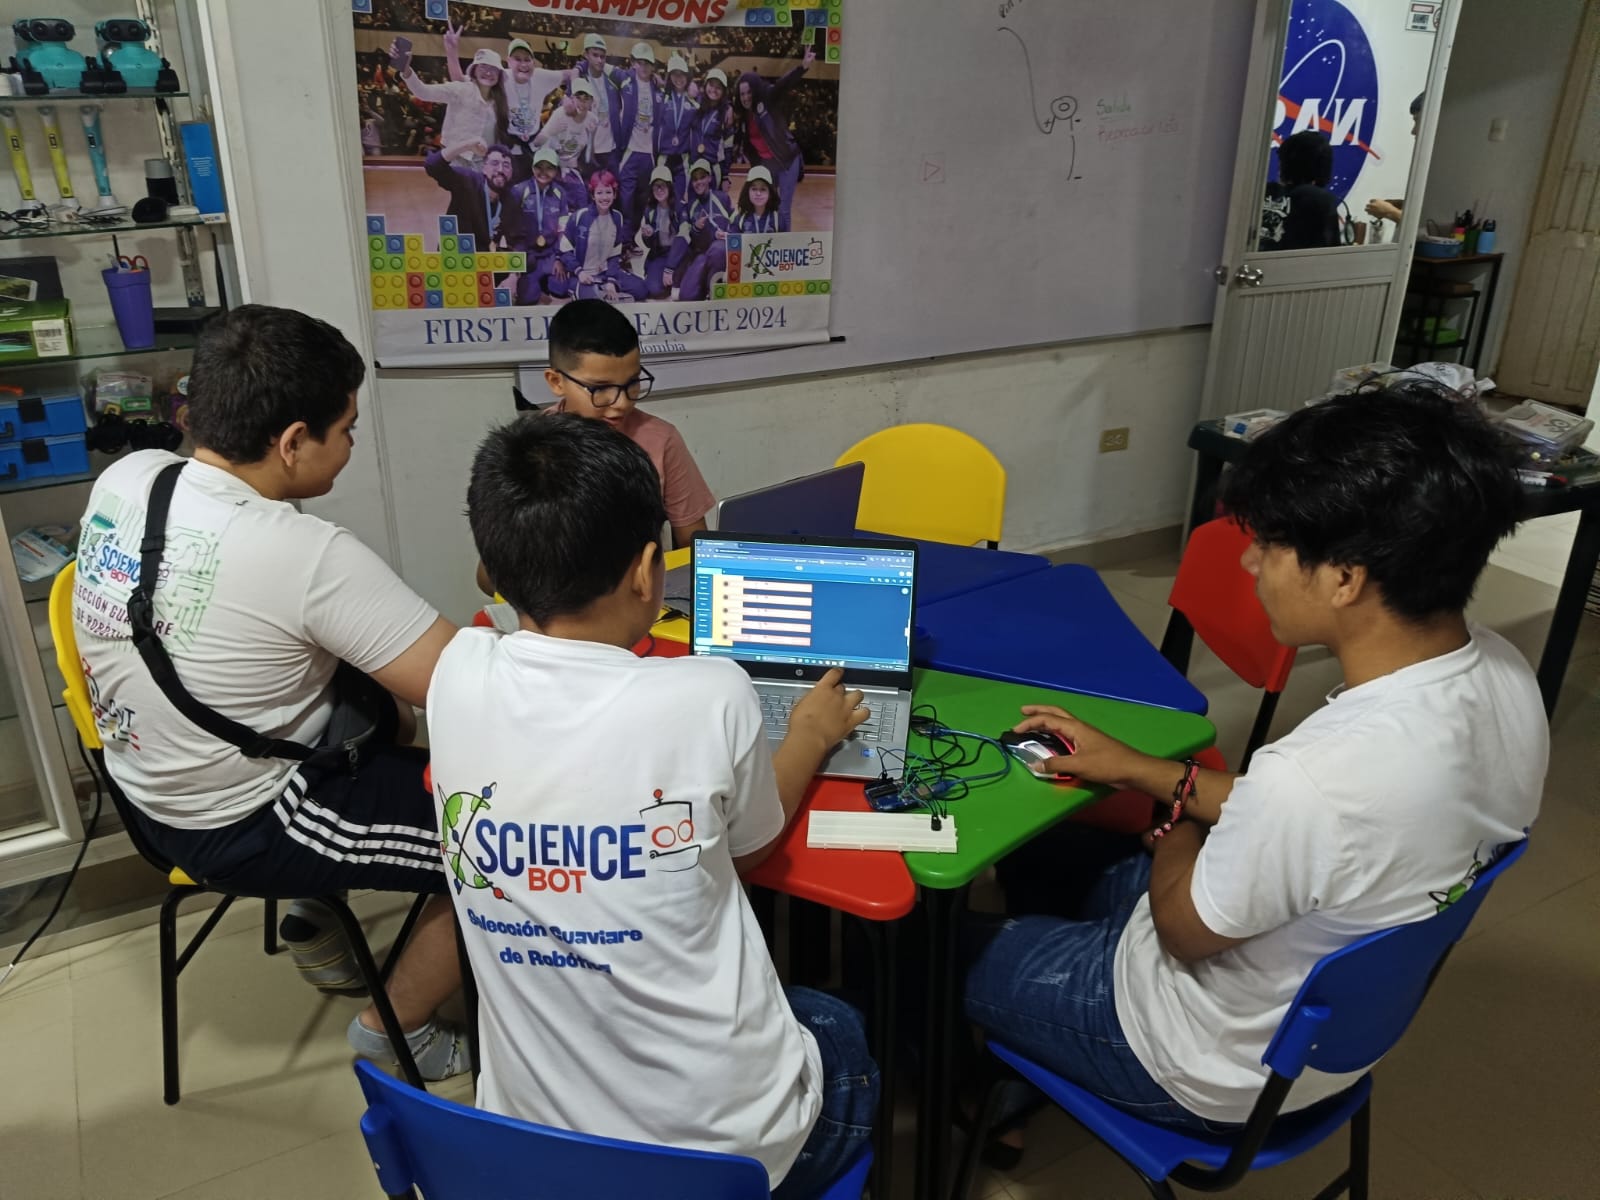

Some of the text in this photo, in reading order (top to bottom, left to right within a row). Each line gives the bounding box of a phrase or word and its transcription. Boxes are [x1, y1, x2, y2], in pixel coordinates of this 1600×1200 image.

[528, 0, 728, 24] AMPIONS
[765, 249, 809, 267] SCIENCE
[779, 263, 795, 271] BOT
[424, 317, 515, 344] FIRST
[633, 308, 730, 336] EAGUE
[736, 306, 788, 331] 2024
[640, 339, 687, 353] lombia
[100, 545, 141, 583] SCIENC
[110, 570, 130, 584] BOT
[475, 818, 646, 882] SCIENCE
[528, 867, 587, 894] BOT
[499, 947, 524, 965] de
